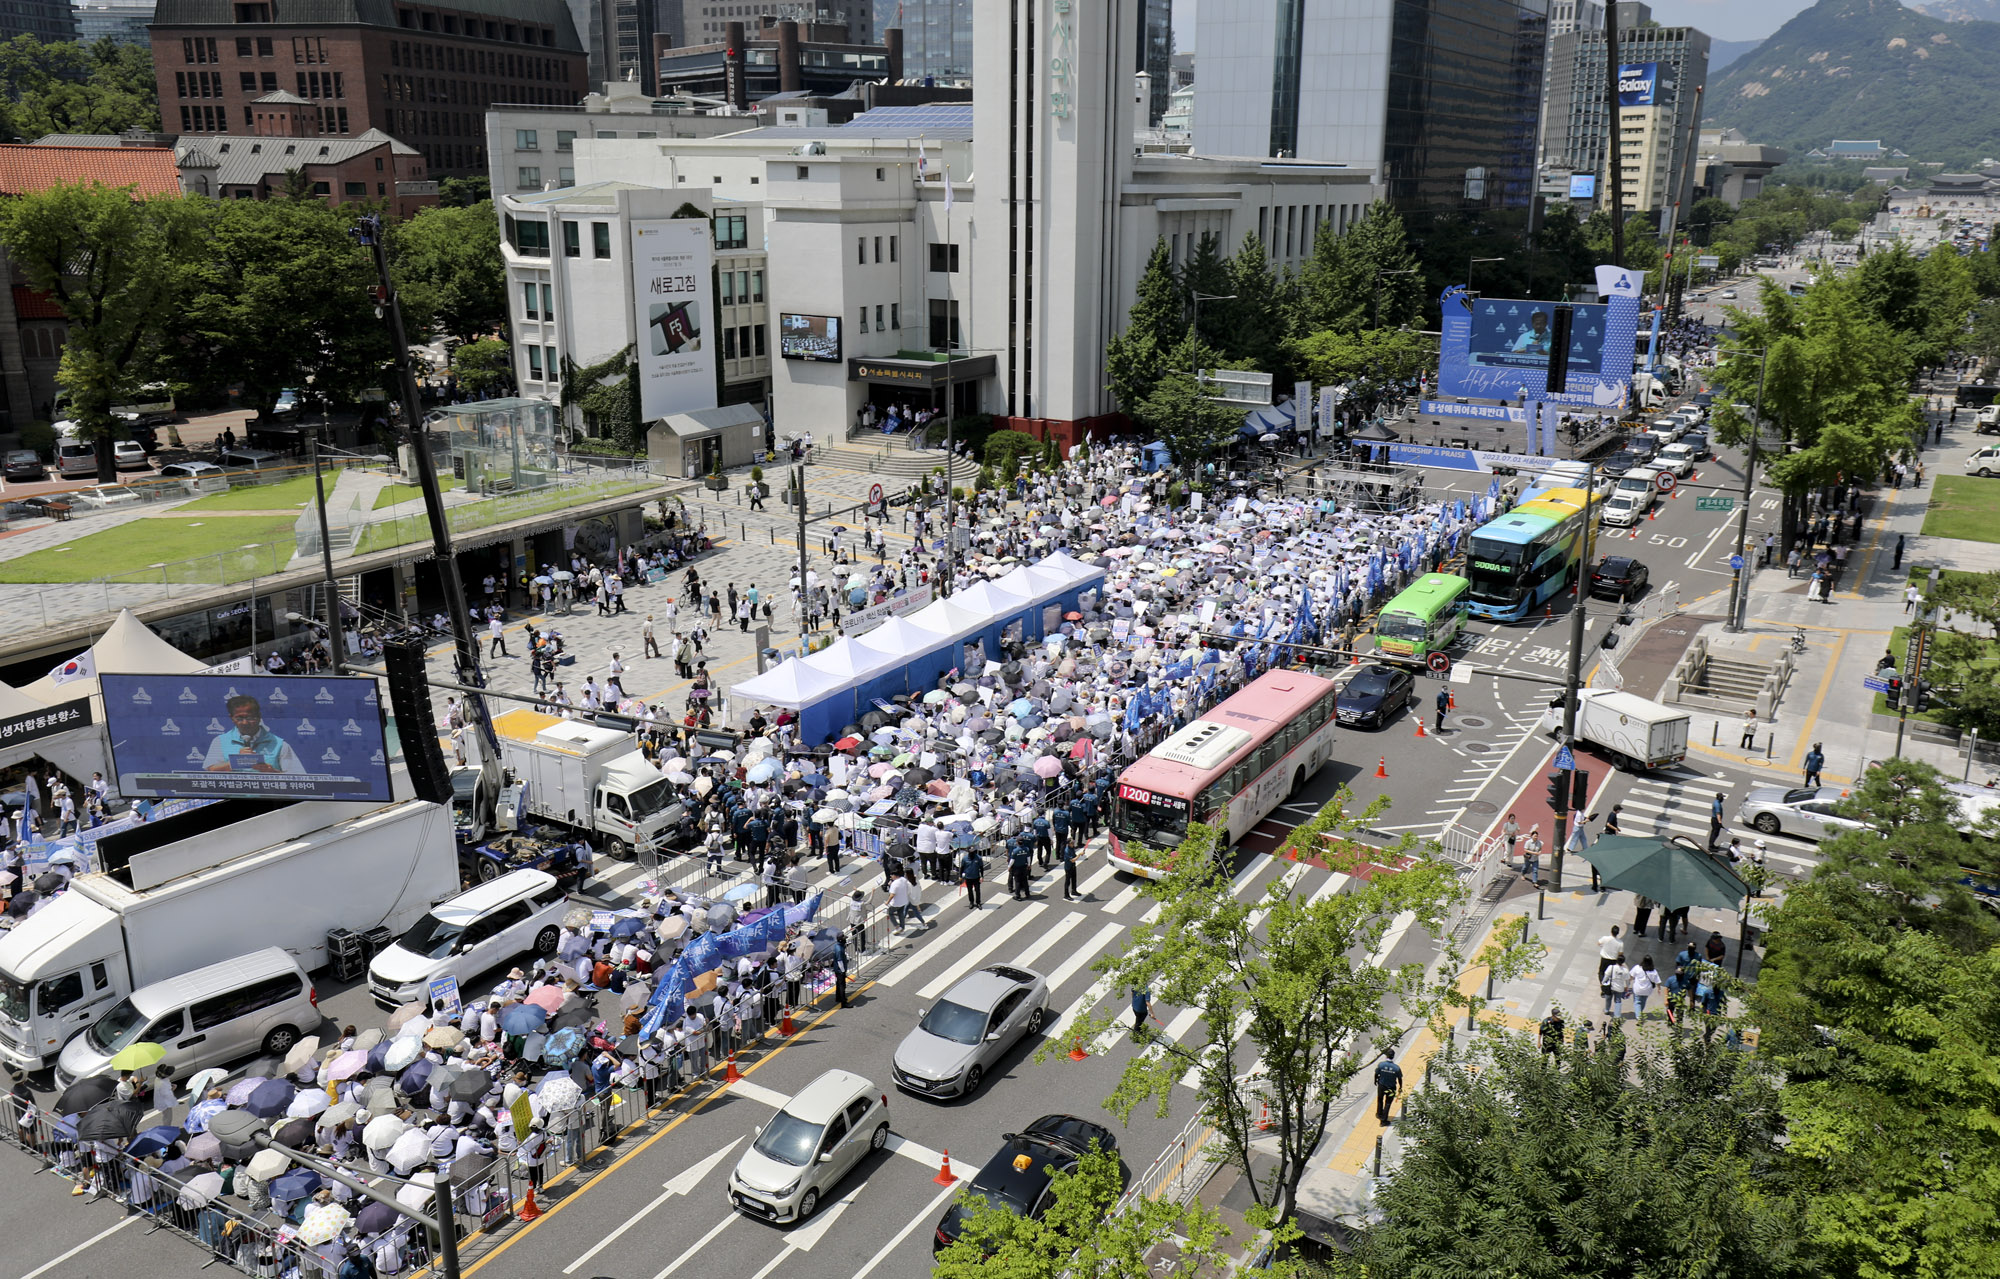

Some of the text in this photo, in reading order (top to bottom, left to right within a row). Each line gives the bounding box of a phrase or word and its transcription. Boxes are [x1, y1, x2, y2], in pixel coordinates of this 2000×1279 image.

[1618, 79, 1652, 93] Galaxy
[650, 275, 696, 294] 새로고침
[668, 317, 683, 335] F5
[868, 368, 922, 380] 서울특별시의회
[1458, 369, 1522, 393] Holy Korea
[1578, 376, 1599, 386] 2023
[1400, 446, 1433, 454] WORSHIP
[1441, 449, 1466, 458] PRAISE
[1482, 454, 1521, 463] 2023.07.01
[1648, 533, 1688, 548] 50
[1475, 561, 1500, 571] 5000A
[230, 606, 250, 616] SEOUL
[0, 708, 80, 739] 생자합동분향소
[191, 780, 315, 790] 포괄적 차별금지법 반대를 위하여
[1123, 786, 1150, 803] 1200
